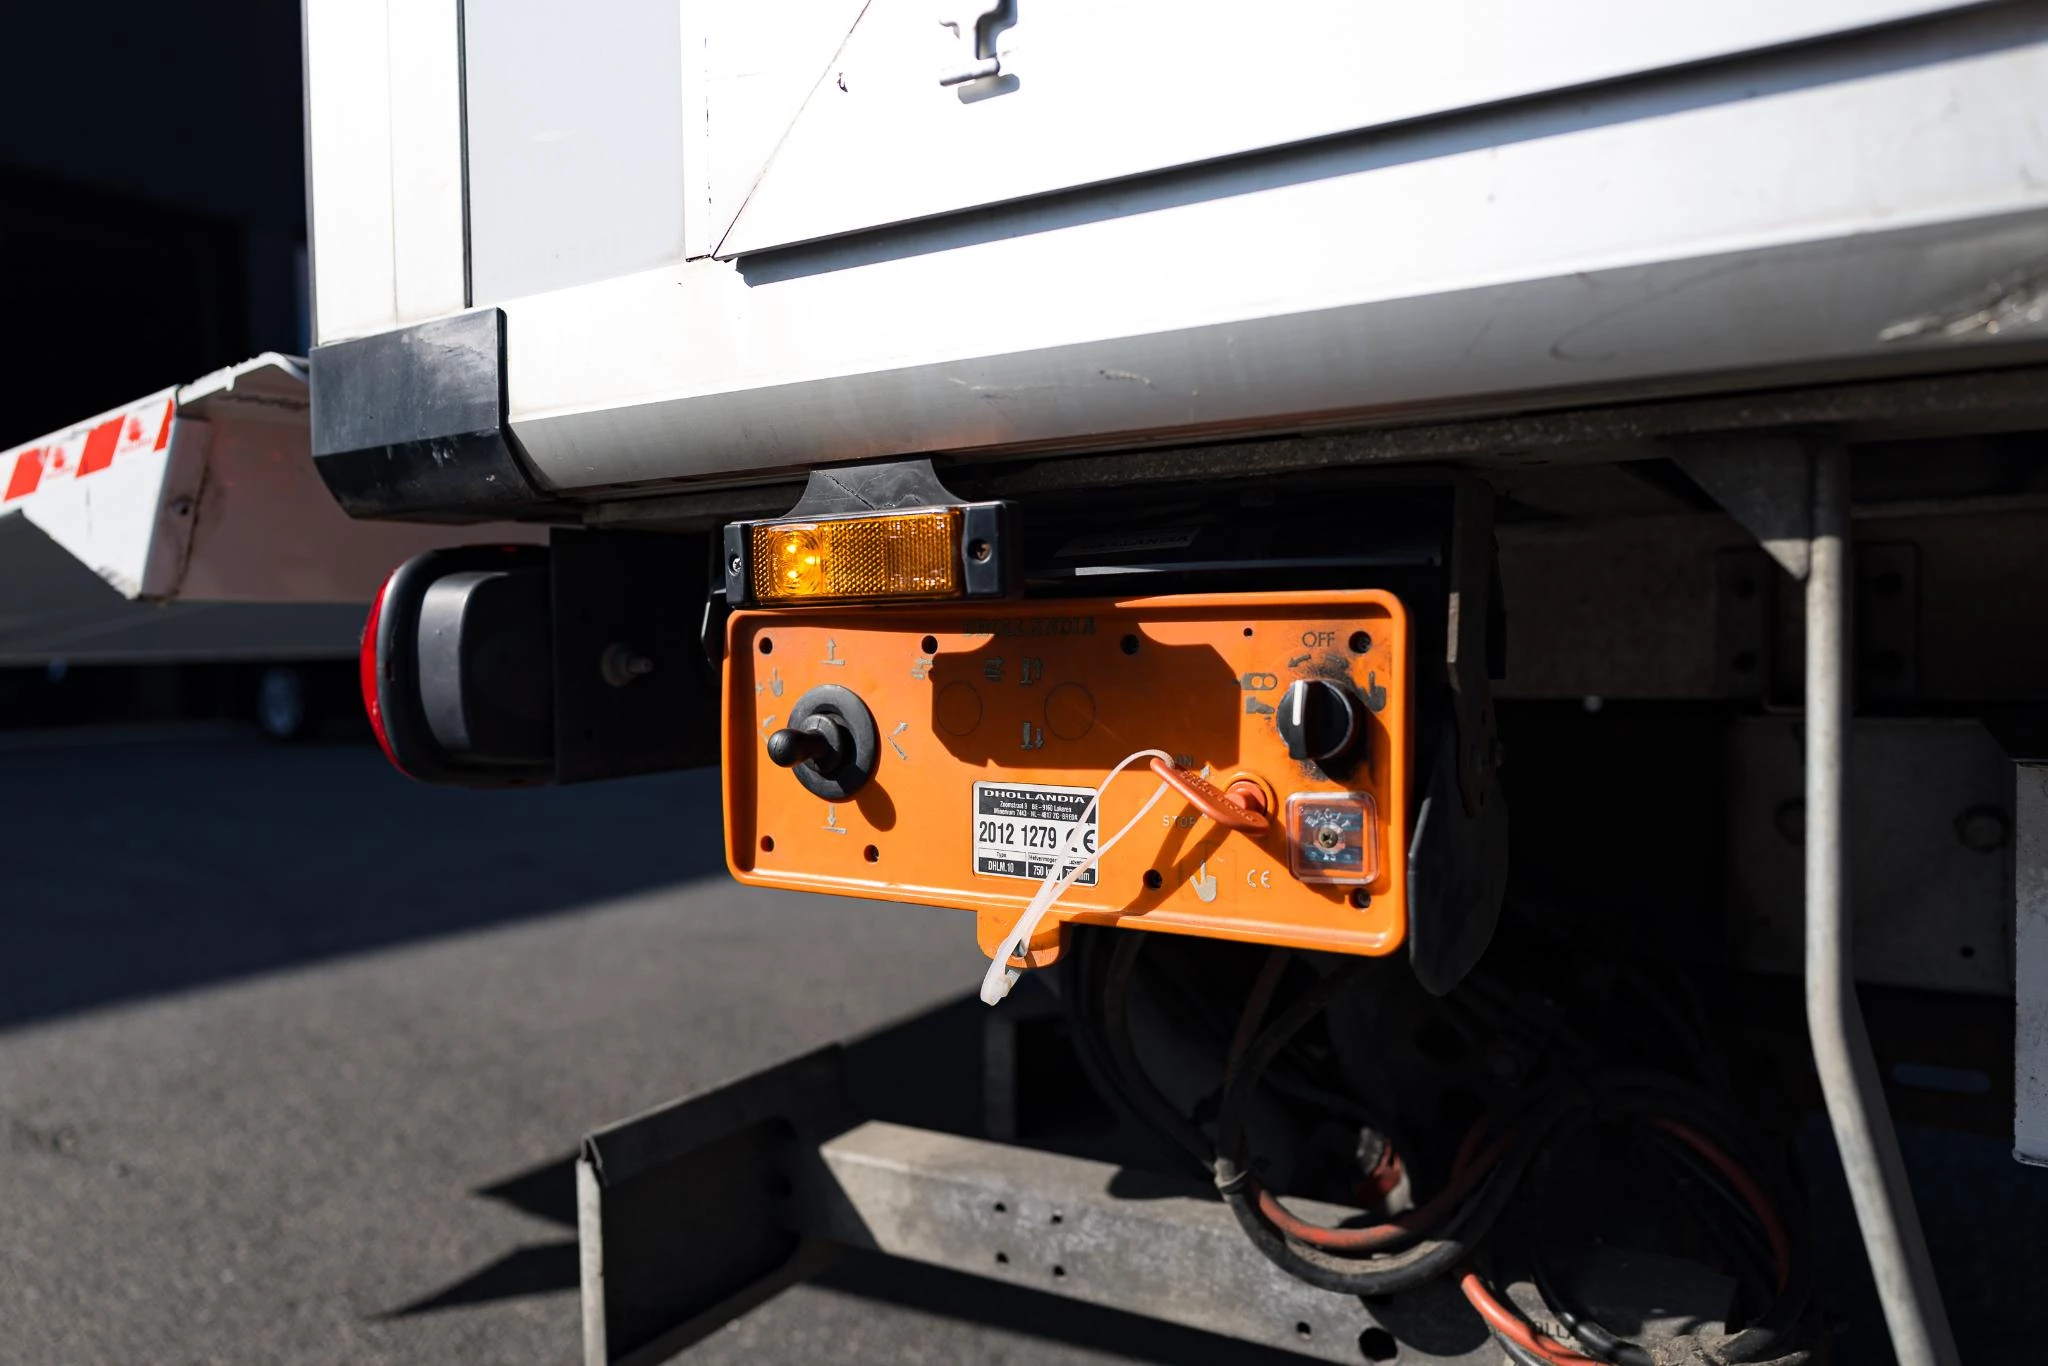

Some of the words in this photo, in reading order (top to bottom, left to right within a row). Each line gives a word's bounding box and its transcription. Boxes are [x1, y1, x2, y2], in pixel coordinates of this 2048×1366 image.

[1302, 631, 1335, 648] OFF
[984, 789, 1086, 804] DHOLLANDIA
[1162, 815, 1196, 828] STOP
[979, 821, 1015, 845] 2012
[1021, 824, 1057, 849] 1279
[1033, 865, 1045, 876] 750
[1246, 869, 1272, 888] CE
